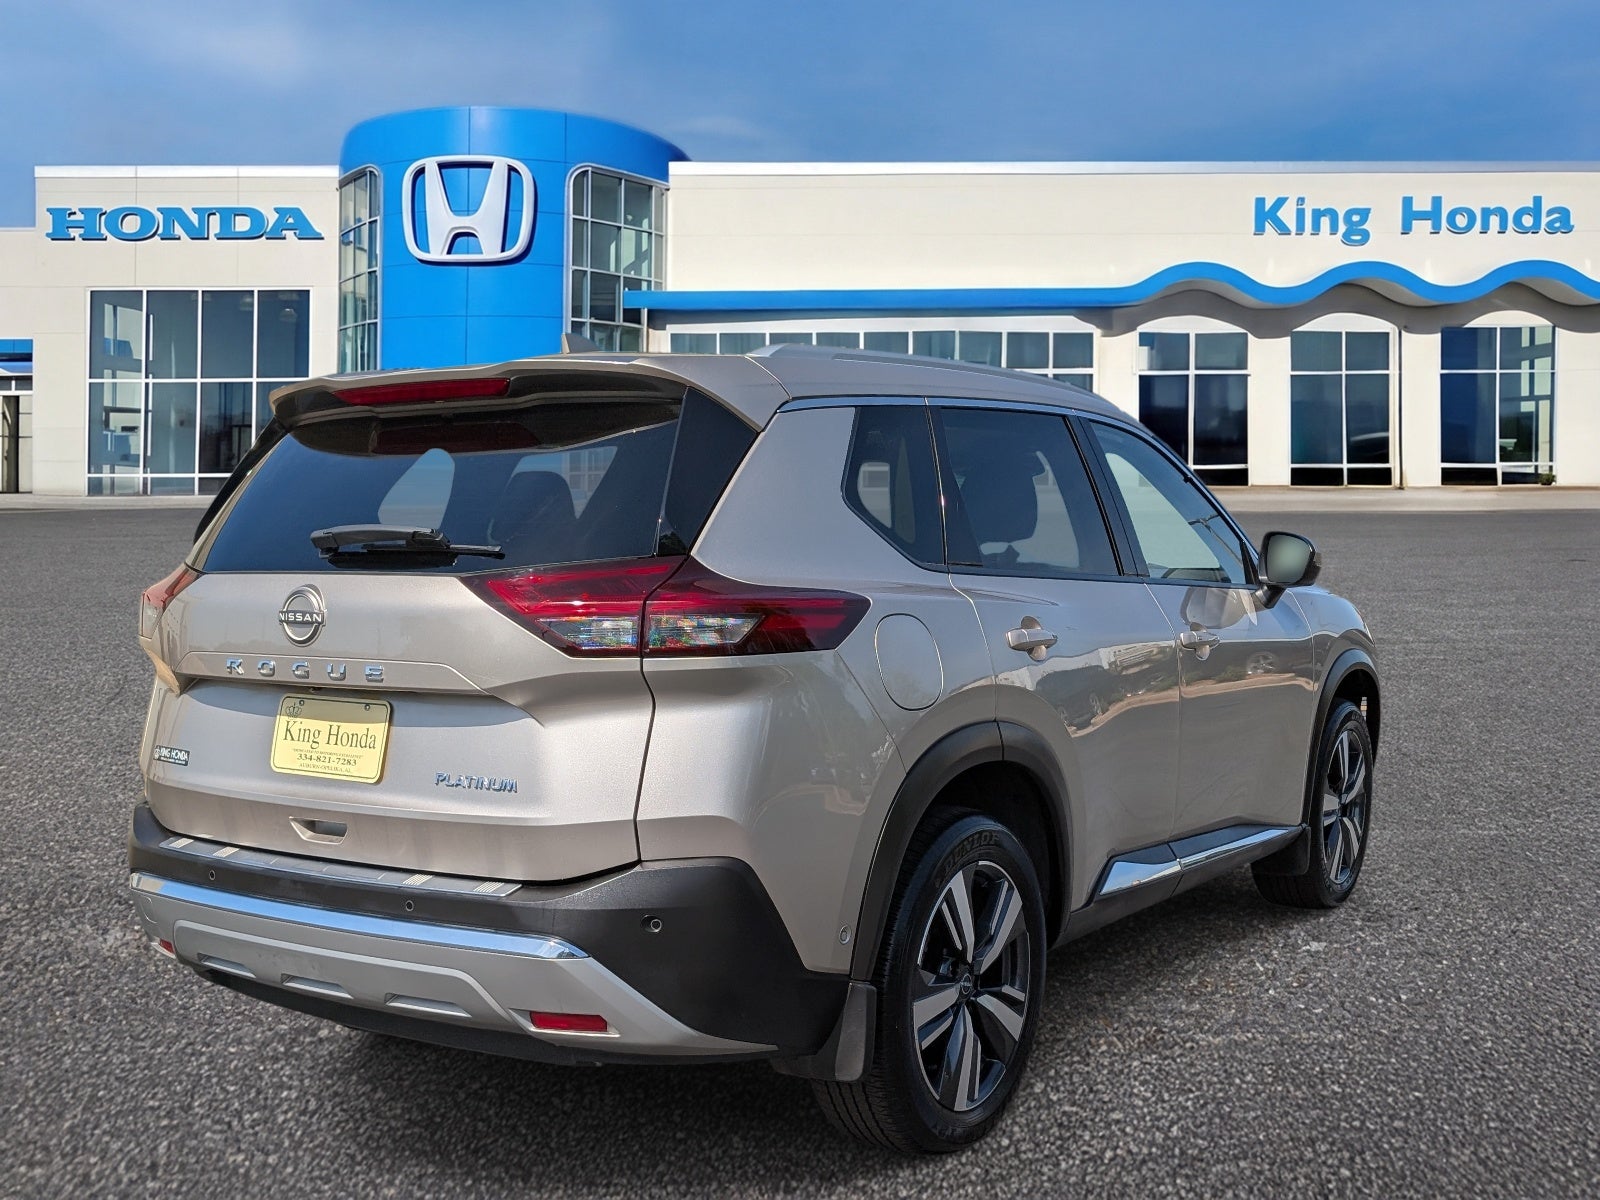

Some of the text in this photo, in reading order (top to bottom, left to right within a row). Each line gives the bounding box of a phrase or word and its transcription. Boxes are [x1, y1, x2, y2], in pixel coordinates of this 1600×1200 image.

[45, 206, 324, 242] HONDA
[1253, 195, 1575, 246] King Honda
[279, 611, 323, 623] NISSAN
[226, 657, 385, 684] ROGUE
[282, 719, 377, 750] King Honda
[296, 753, 358, 767] 334-821-7283
[434, 771, 518, 794] PLATINUM
